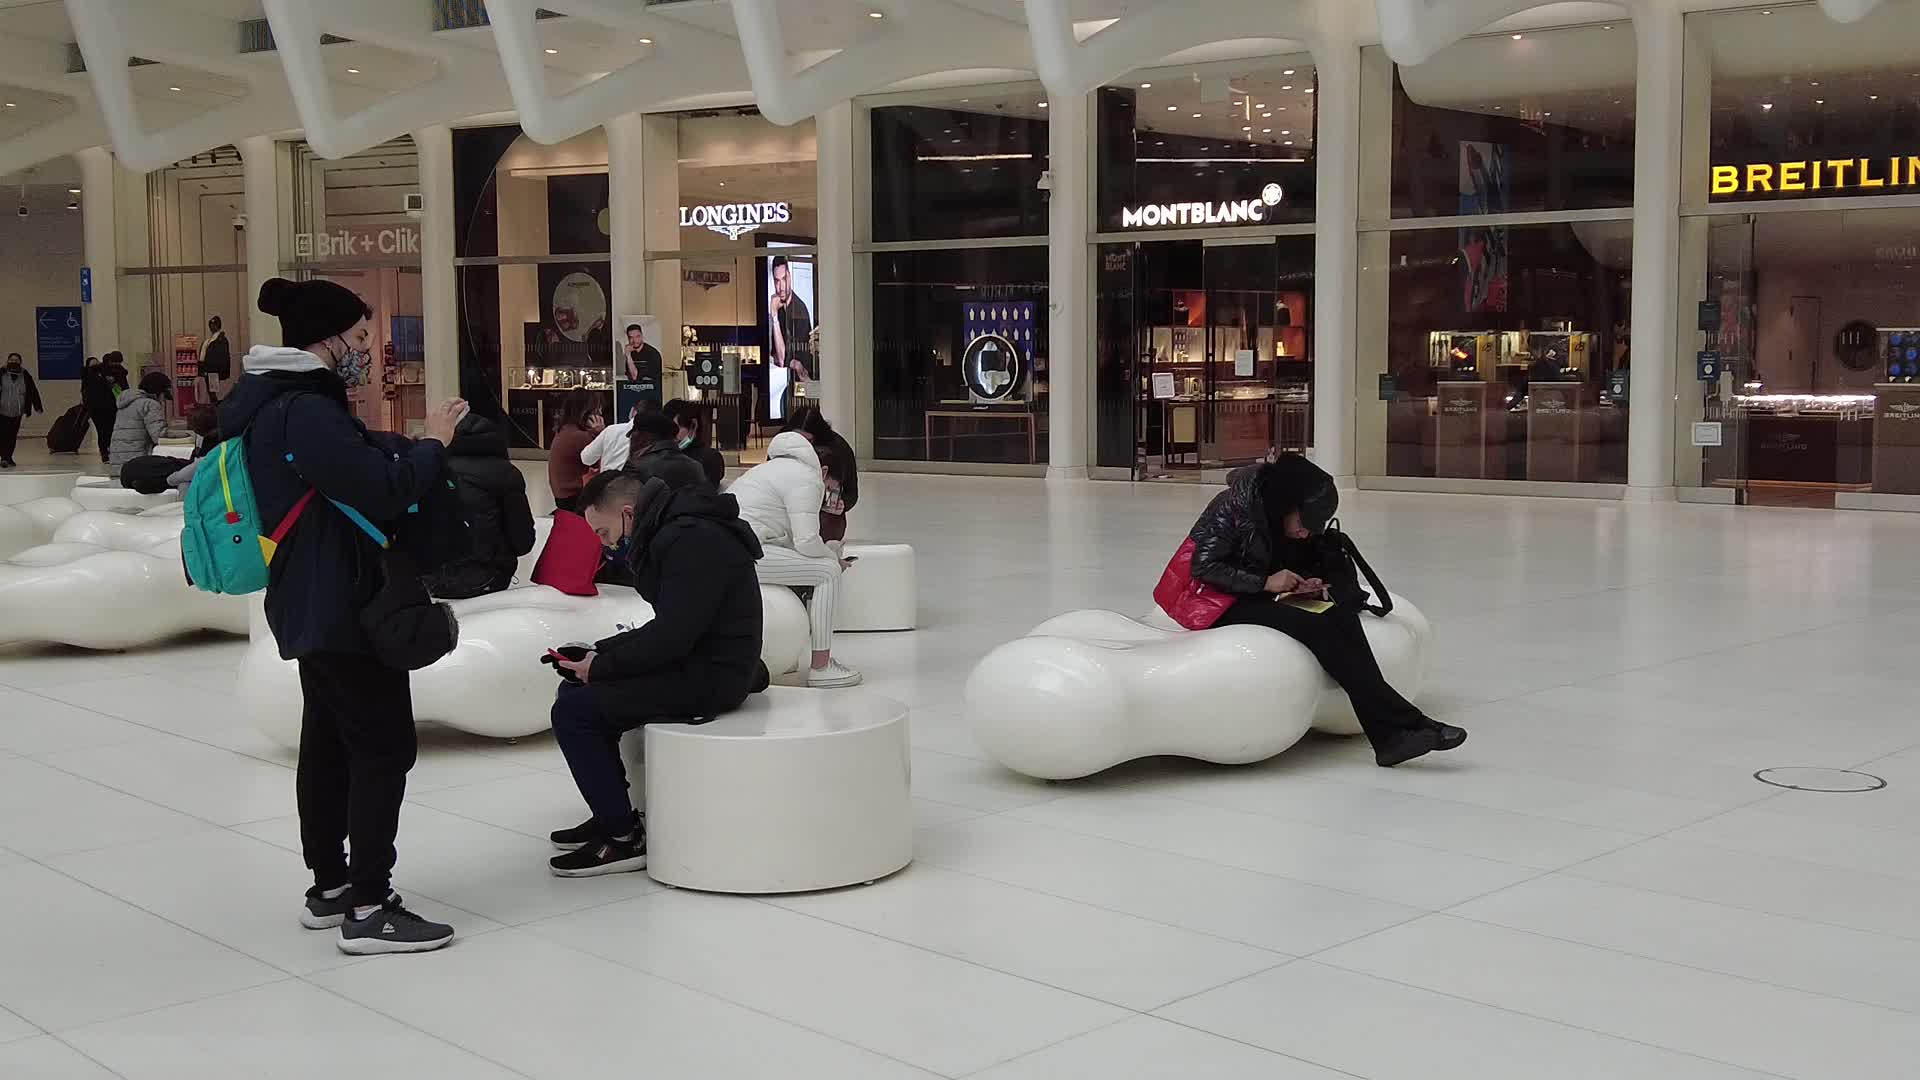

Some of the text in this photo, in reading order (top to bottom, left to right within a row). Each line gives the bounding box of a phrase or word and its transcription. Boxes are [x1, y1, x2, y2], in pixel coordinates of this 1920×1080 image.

[680, 202, 790, 226] LONGINES
[1122, 199, 1263, 227] MONTBLANC
[319, 230, 359, 256] Brik
[378, 227, 420, 254] Clik
[1105, 254, 1127, 263] MONT
[1105, 262, 1127, 271] BLANC
